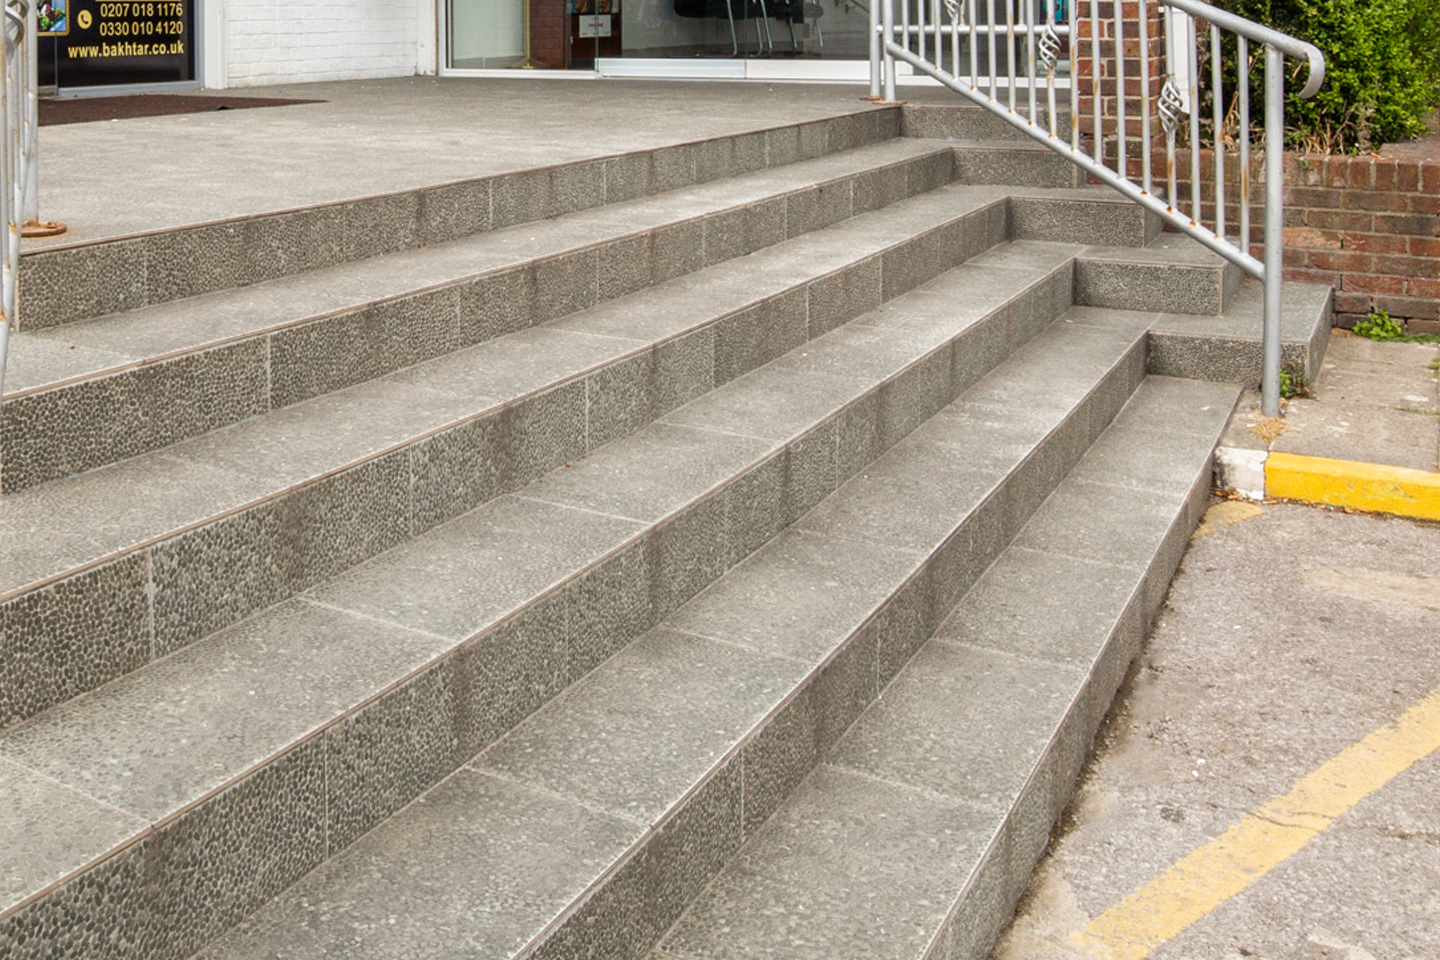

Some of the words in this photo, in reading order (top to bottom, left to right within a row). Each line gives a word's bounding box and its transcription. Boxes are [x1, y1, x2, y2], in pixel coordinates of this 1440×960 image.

[100, 3, 130, 18] 0207
[132, 3, 154, 18] 018
[156, 2, 183, 17] 1176
[99, 21, 130, 37] 0330
[132, 21, 154, 37] 010
[155, 21, 184, 36] 4120
[68, 40, 184, 58] www.bakhtar.co.uk
